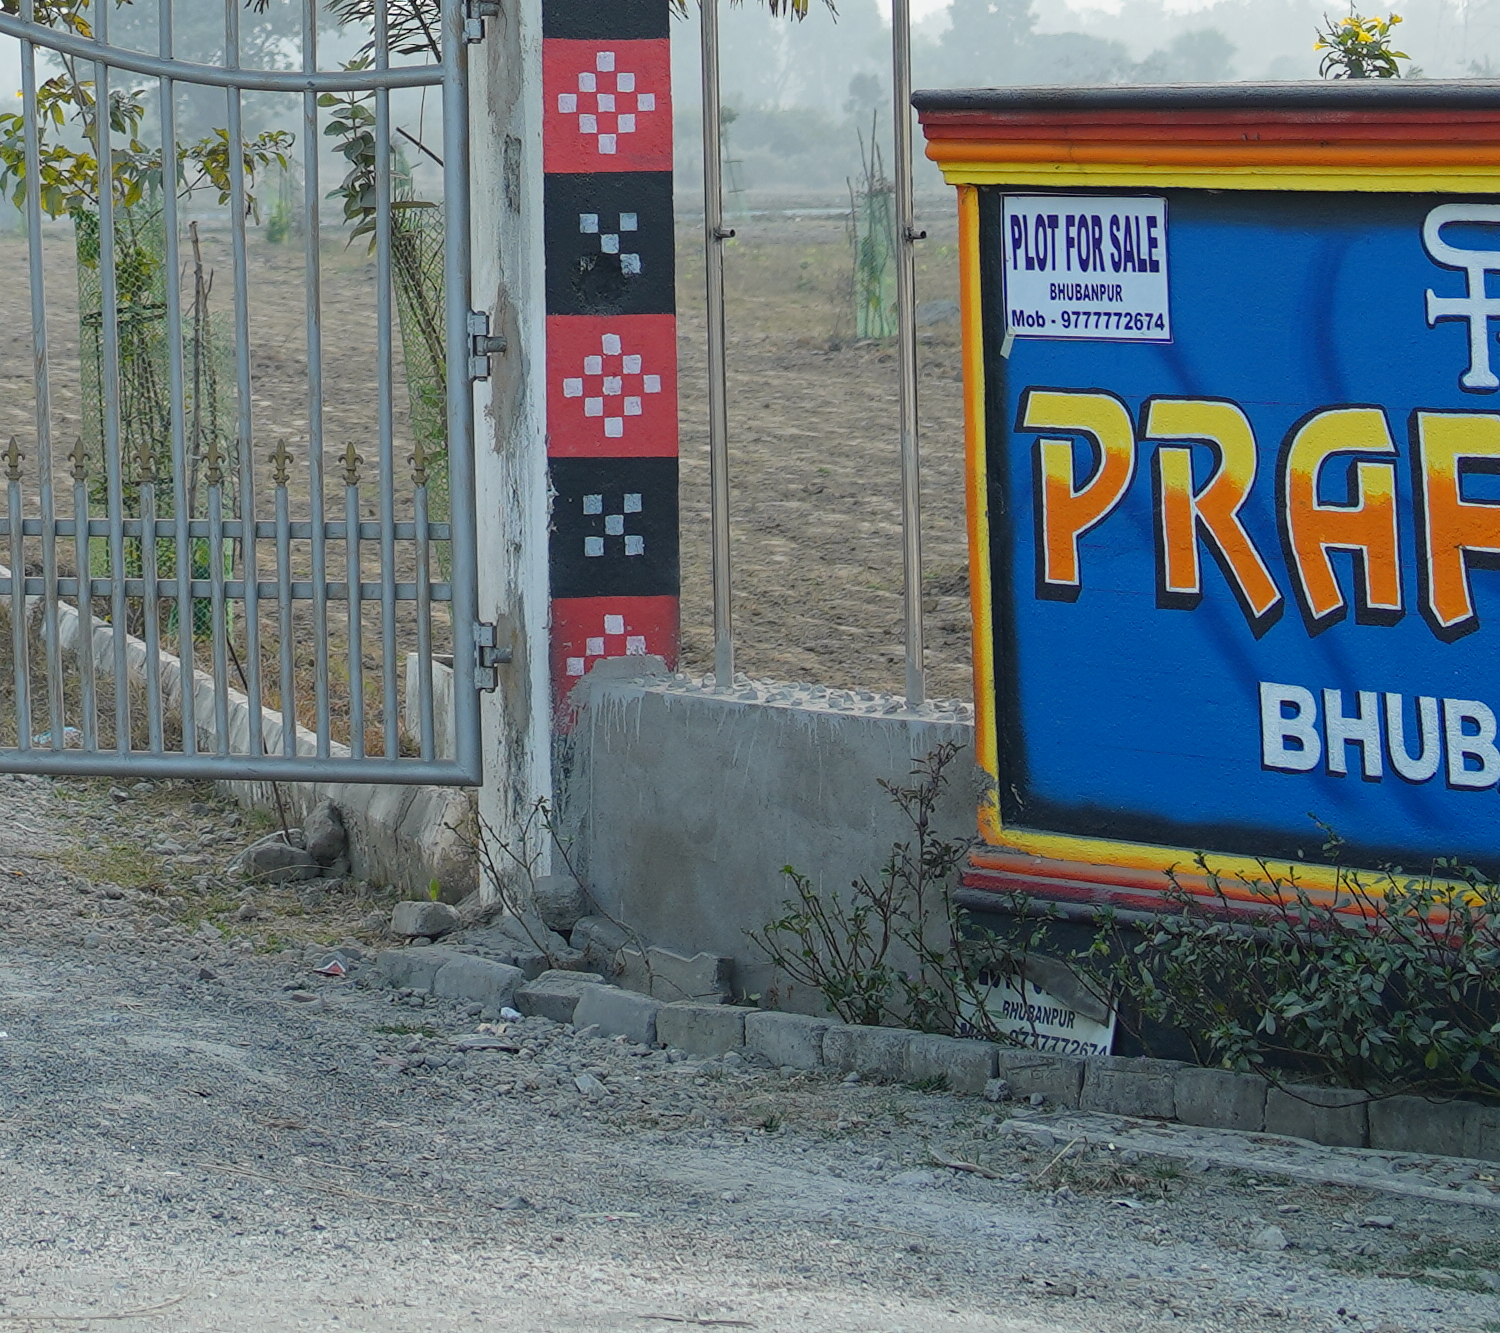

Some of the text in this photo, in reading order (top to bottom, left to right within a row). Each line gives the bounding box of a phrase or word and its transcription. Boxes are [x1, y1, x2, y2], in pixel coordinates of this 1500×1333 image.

[1010, 213, 1161, 274] PLOT FOR SALE
[1049, 282, 1124, 303] BHUBANPUR
[1011, 309, 1046, 329] Mob
[1060, 310, 1165, 331] 9777772674
